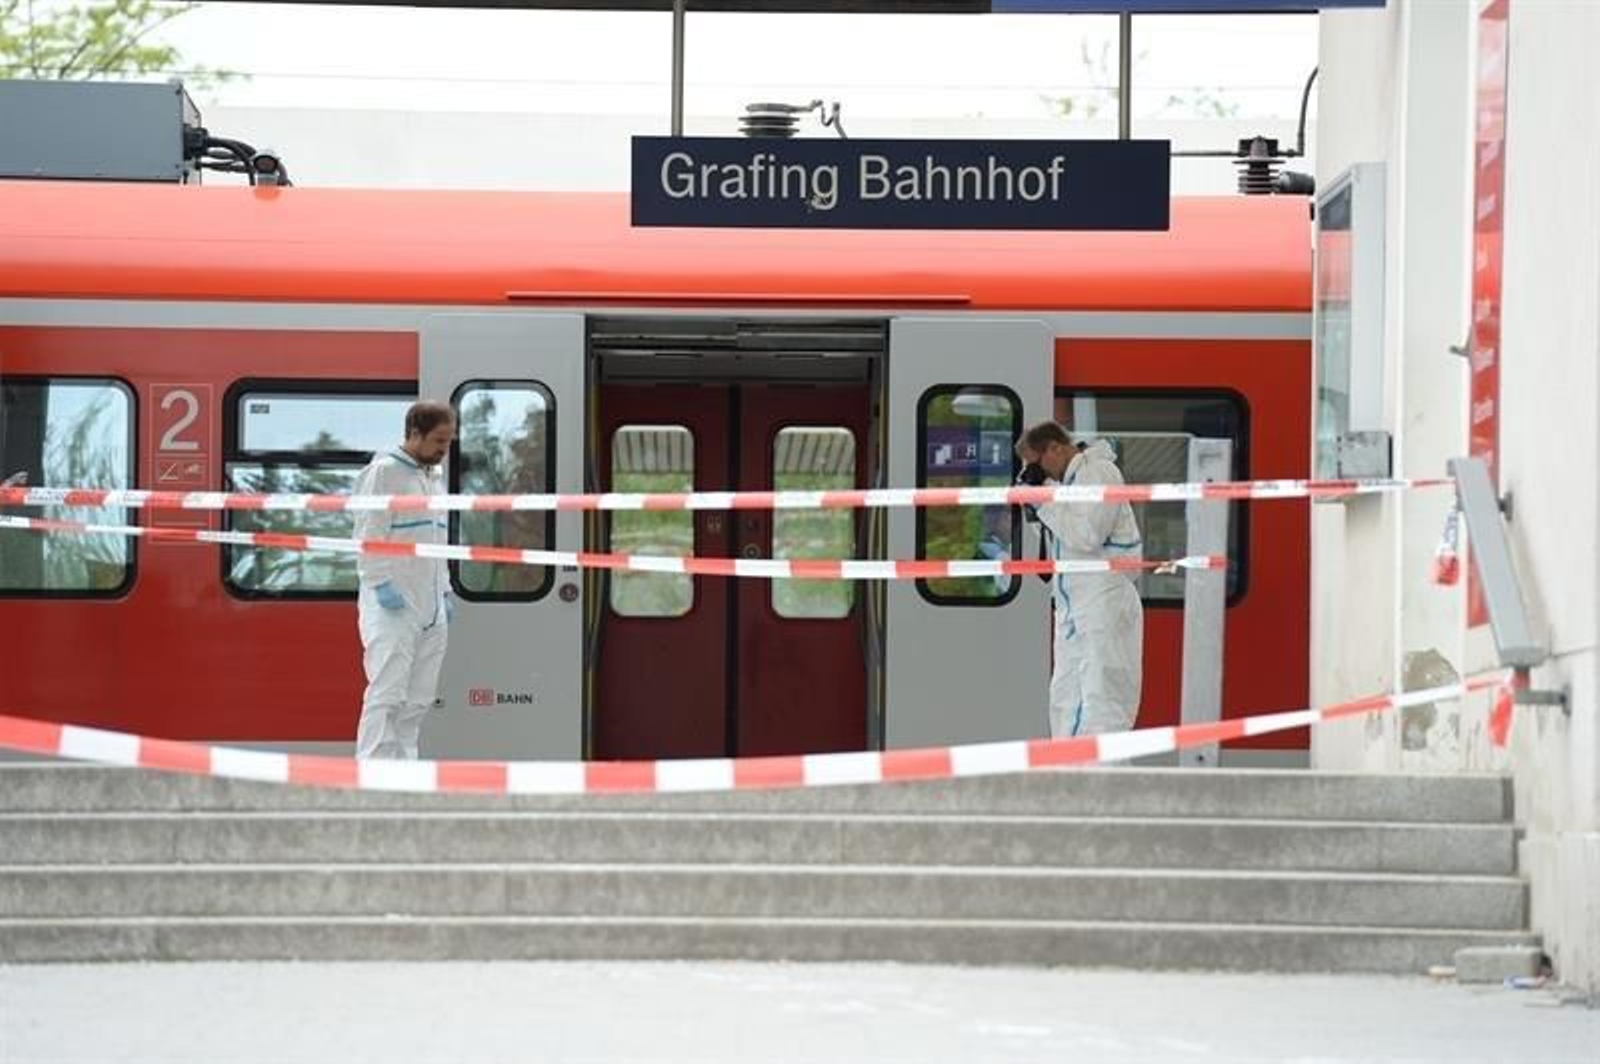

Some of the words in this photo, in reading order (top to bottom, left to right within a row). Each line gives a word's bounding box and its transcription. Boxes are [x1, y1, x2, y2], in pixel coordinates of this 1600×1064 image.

[660, 152, 839, 210] Grafing
[859, 154, 1065, 202] Bahnhof
[159, 389, 199, 450] 2
[497, 693, 533, 704] BAHN
